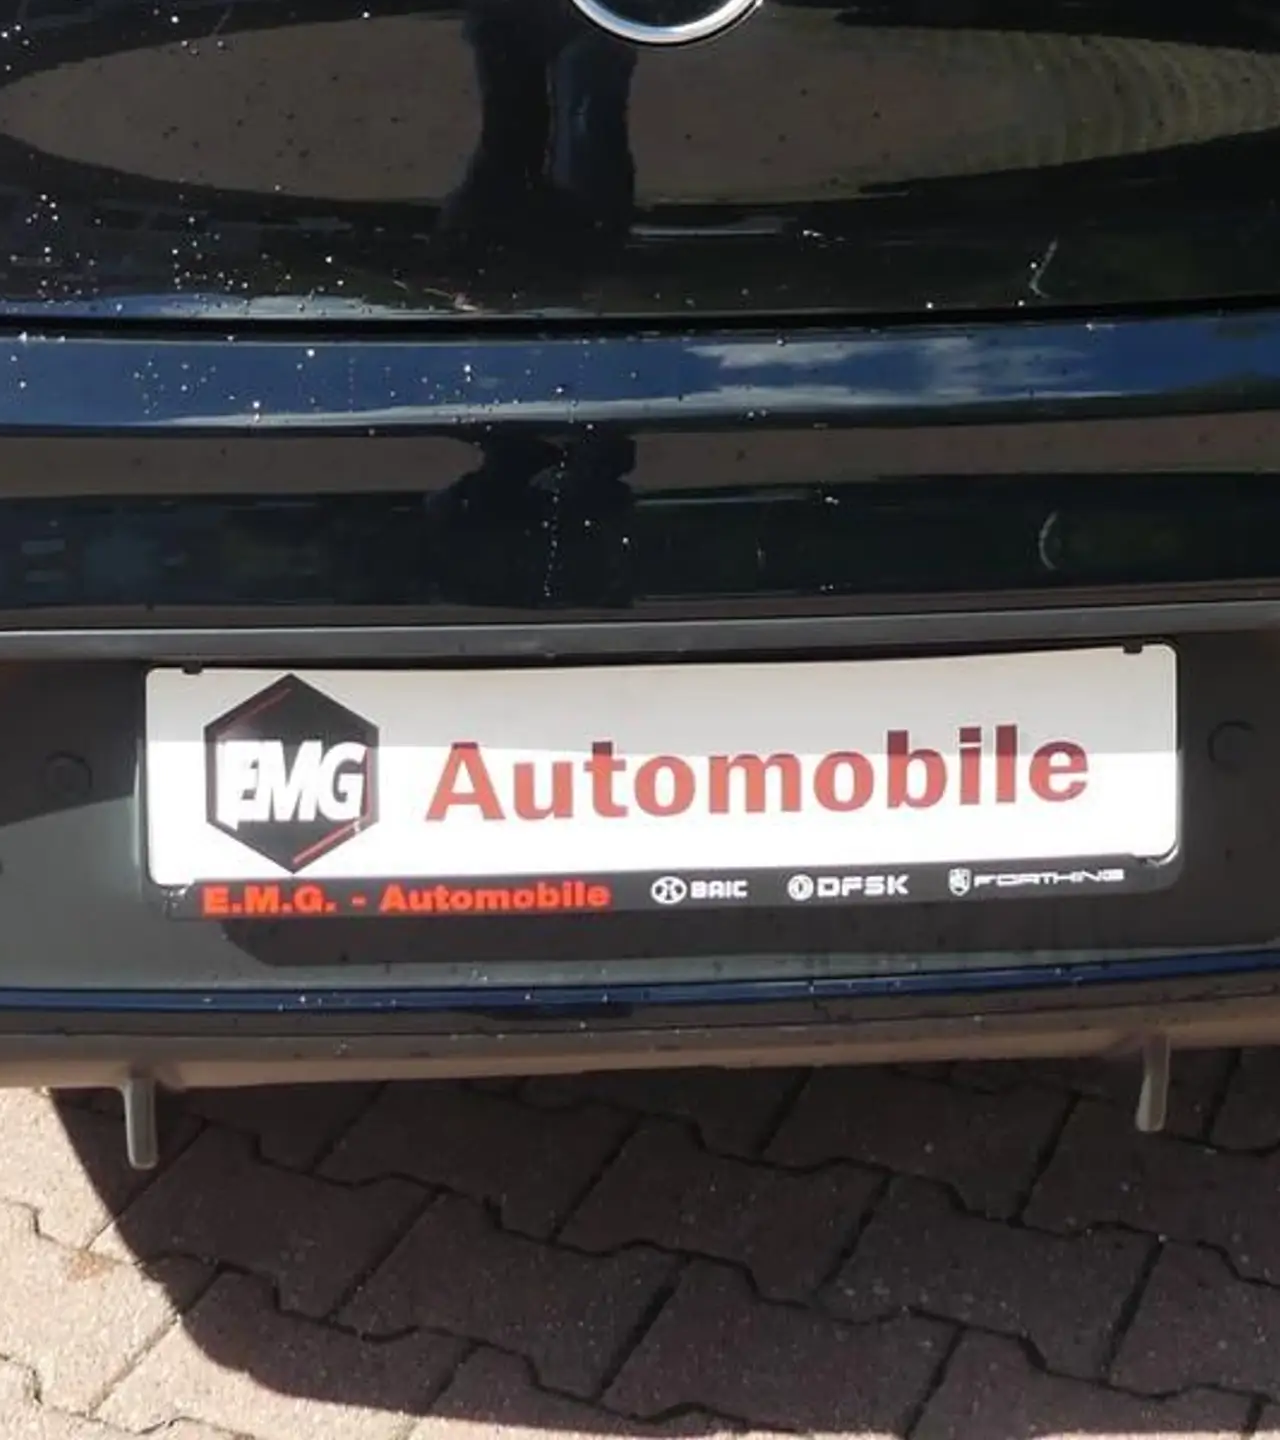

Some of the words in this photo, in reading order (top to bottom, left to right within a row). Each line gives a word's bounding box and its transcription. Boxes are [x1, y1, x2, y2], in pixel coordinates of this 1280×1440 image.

[216, 740, 367, 826] EMG
[426, 725, 1088, 821] Automobile
[203, 883, 335, 914] E.M.G.
[380, 882, 610, 912] Automobile
[691, 880, 748, 900] BAIC
[819, 875, 909, 897] DFSK
